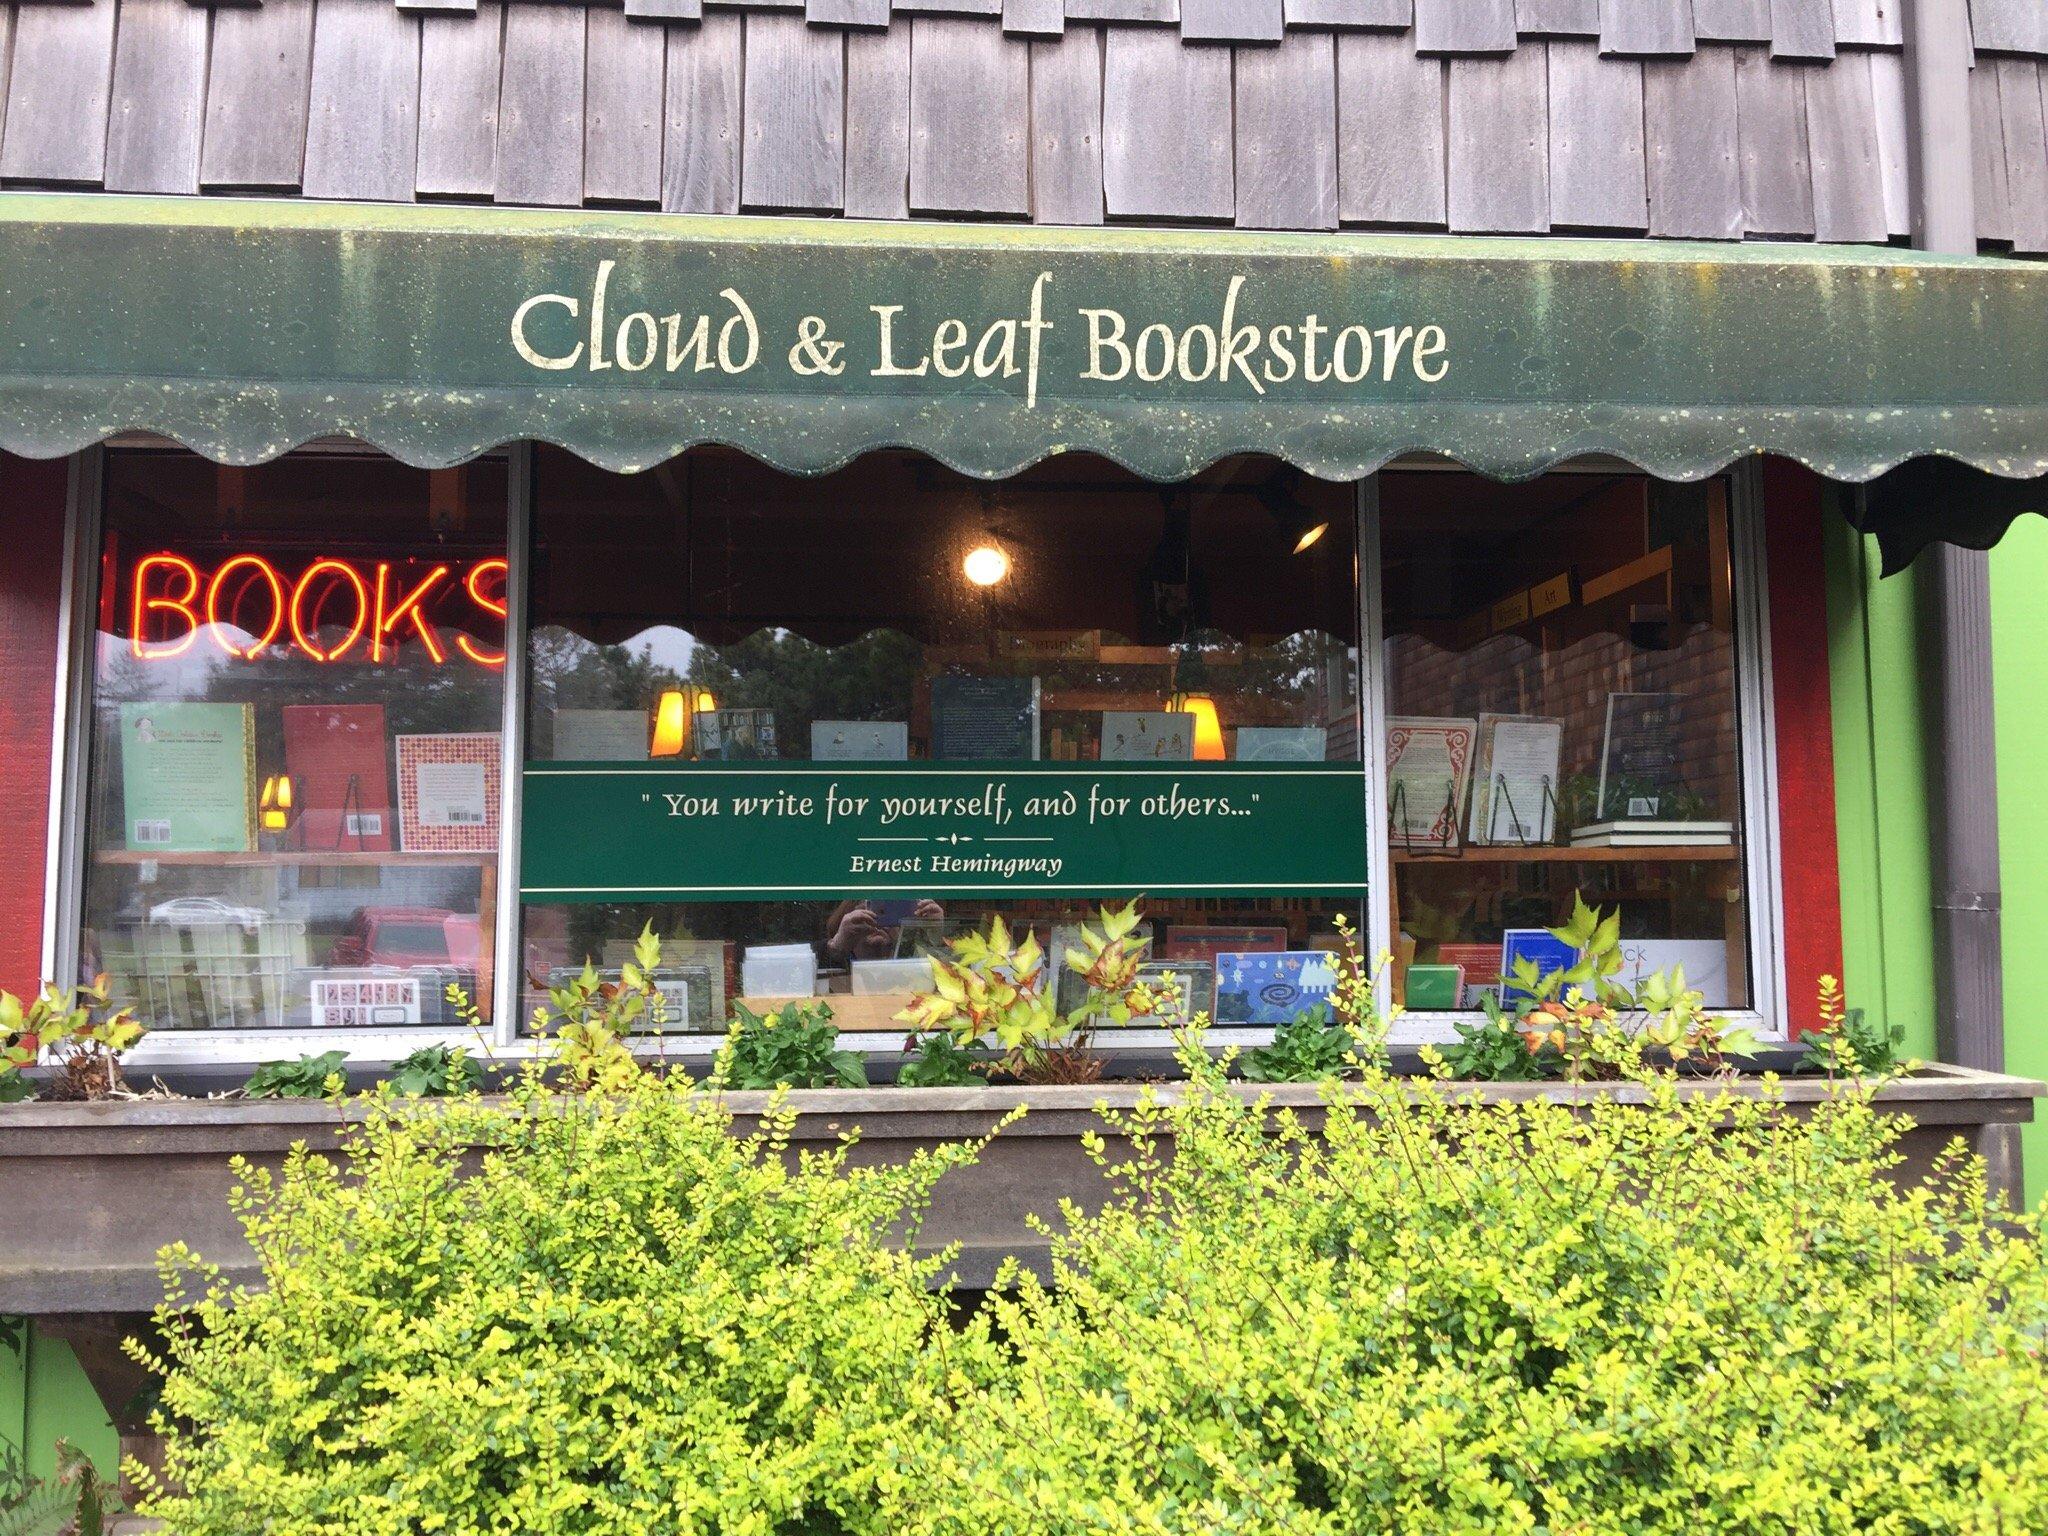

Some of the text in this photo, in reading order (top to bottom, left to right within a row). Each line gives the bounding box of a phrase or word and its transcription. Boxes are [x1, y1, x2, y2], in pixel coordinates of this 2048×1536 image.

[510, 259, 1450, 409] Cloud & Leaf Bookstore
[662, 793, 720, 817] You
[732, 789, 814, 816] write
[825, 782, 869, 825] for
[880, 783, 1013, 826] yourself,
[1023, 790, 1077, 816] and
[1088, 783, 1131, 825] for
[849, 853, 1063, 879] Ernest Hemingway
